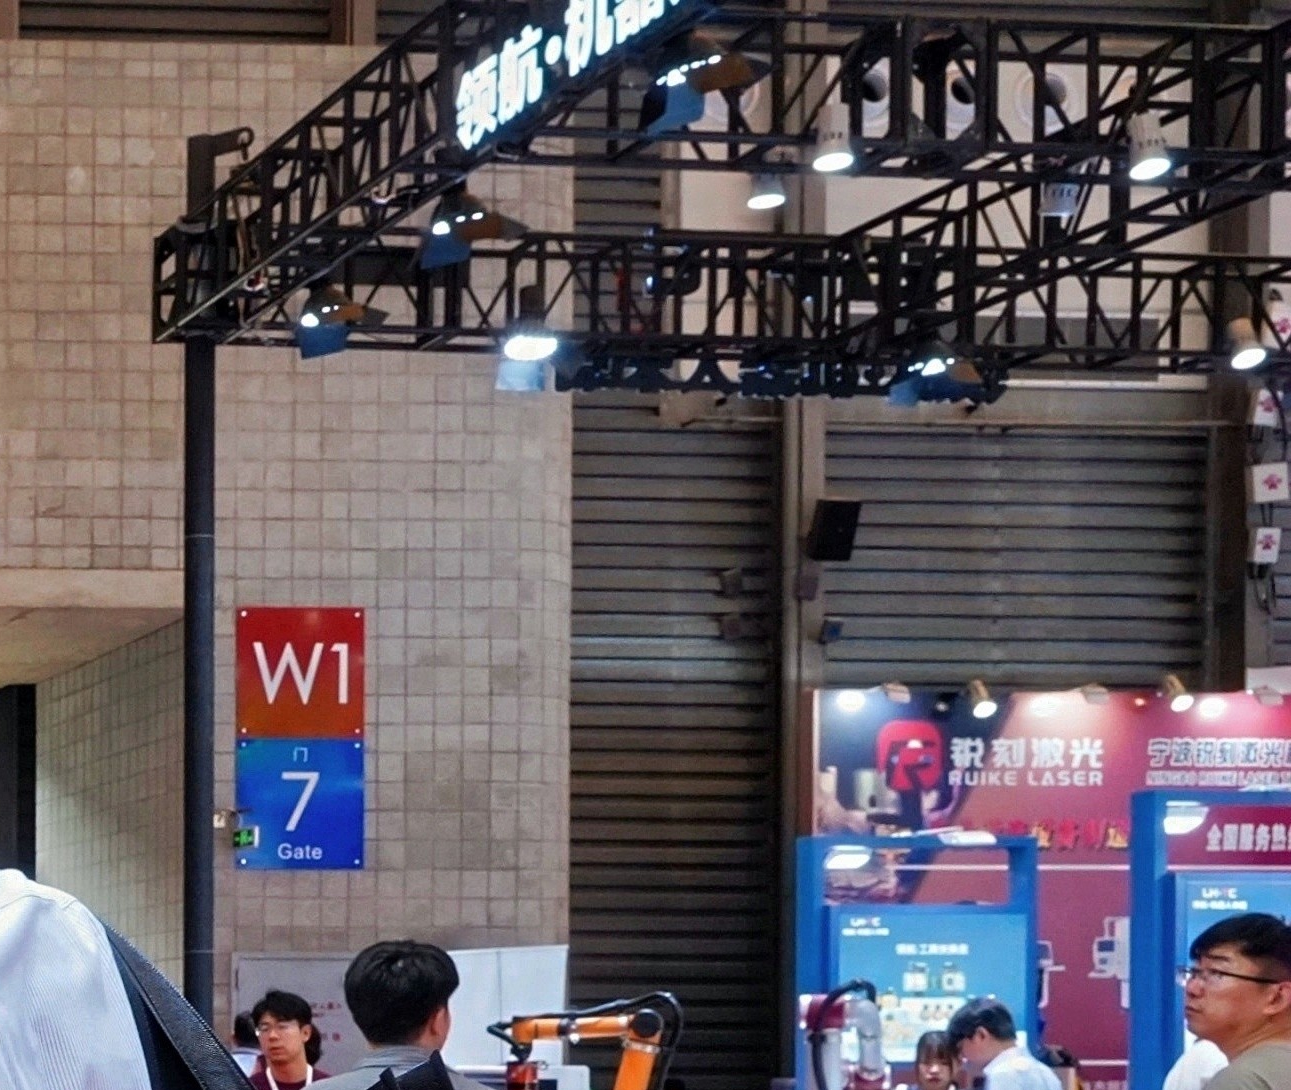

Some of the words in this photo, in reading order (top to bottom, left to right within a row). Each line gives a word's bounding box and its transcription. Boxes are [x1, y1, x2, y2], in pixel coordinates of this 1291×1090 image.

[253, 641, 349, 705] W1
[949, 769, 1017, 786] RUIKE
[1027, 770, 1104, 786] LASER
[281, 771, 319, 831] 7
[277, 843, 323, 861] Gate
